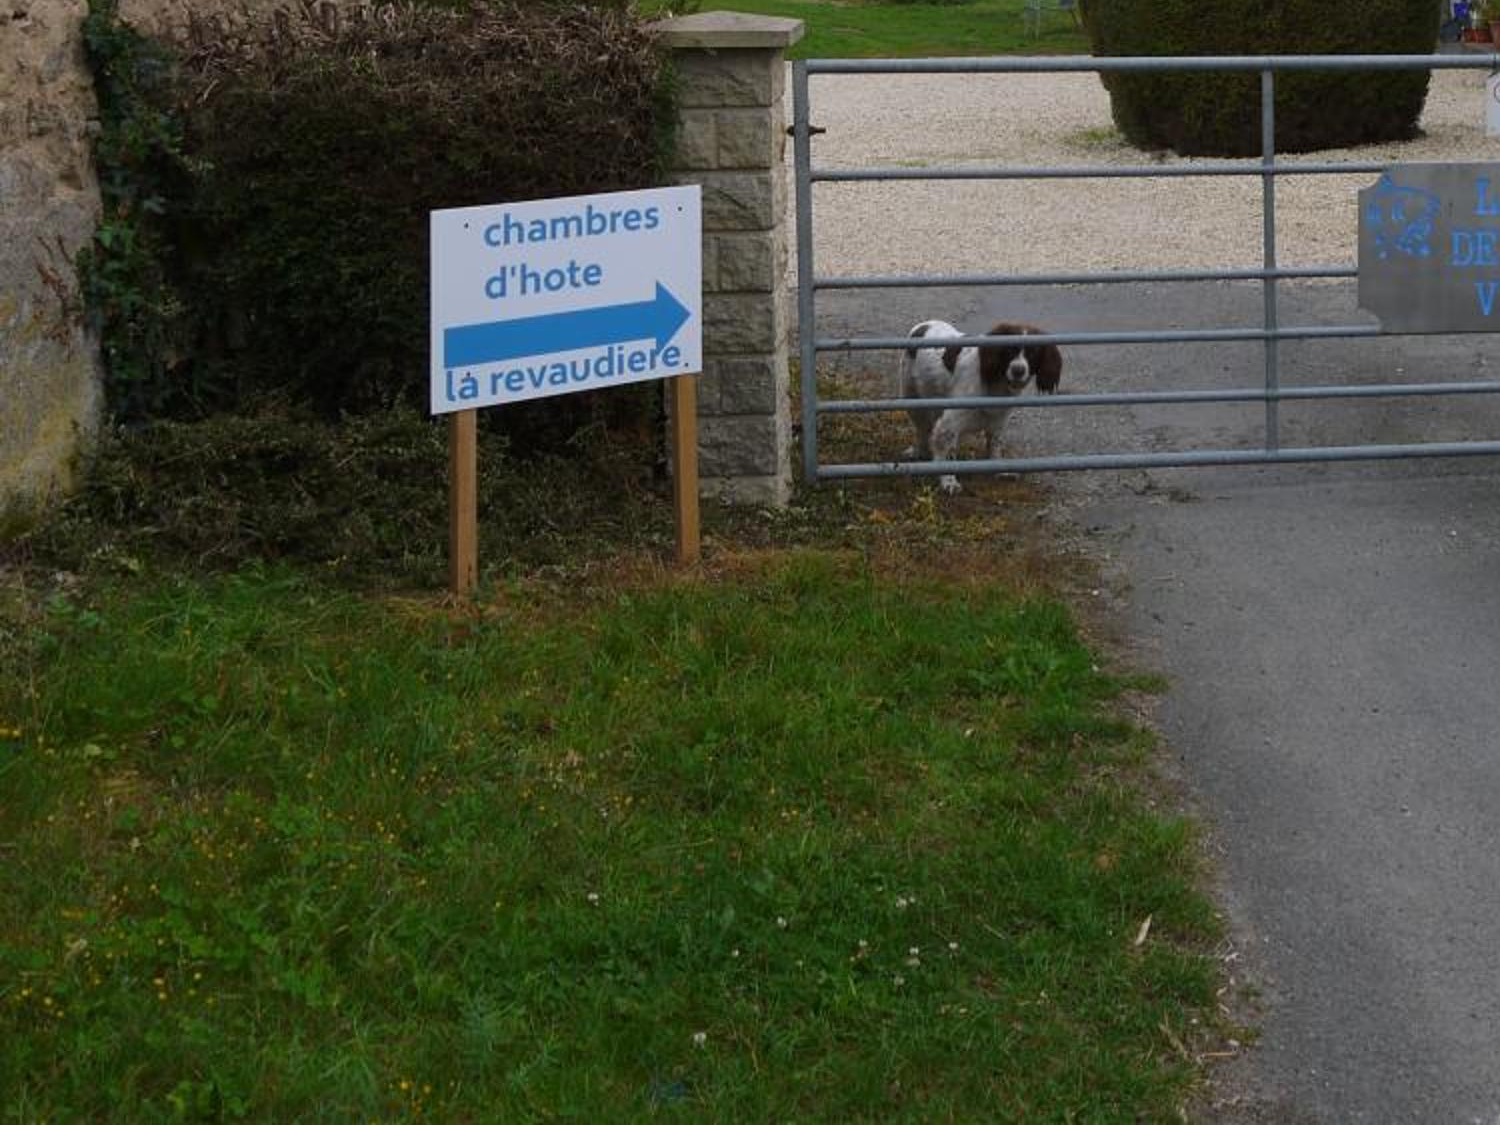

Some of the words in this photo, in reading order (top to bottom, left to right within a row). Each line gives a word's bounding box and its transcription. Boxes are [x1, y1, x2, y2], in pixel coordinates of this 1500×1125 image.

[484, 204, 659, 247] chambres
[1451, 230, 1498, 266] DE
[484, 260, 603, 299] d'hote
[445, 370, 479, 402] la
[490, 345, 681, 396] revaudiere
